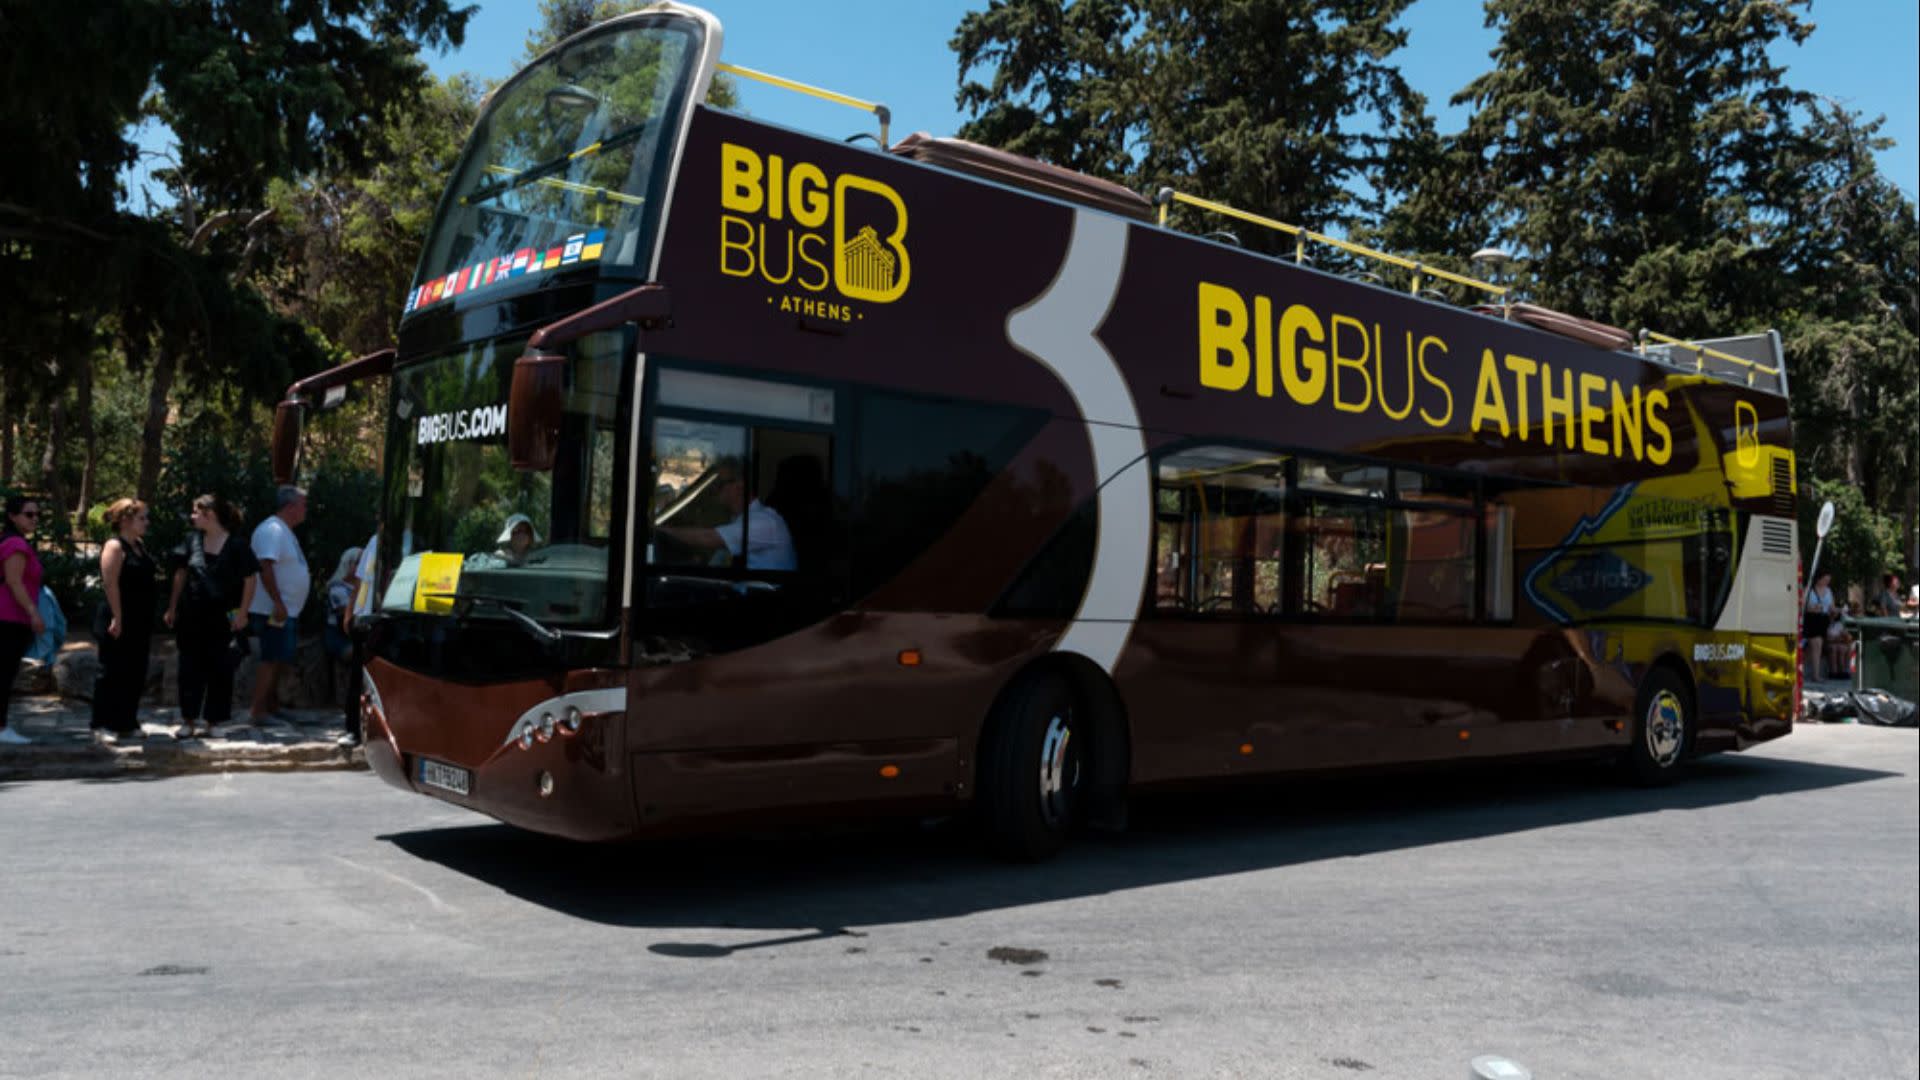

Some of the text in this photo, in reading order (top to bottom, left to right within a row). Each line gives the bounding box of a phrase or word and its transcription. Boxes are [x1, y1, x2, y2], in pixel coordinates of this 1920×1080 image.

[721, 142, 829, 228] BIG
[721, 215, 829, 291] BUS
[780, 295, 852, 322] ATHENS
[417, 403, 508, 445] BIGBUS.COM
[1471, 348, 1673, 466] ATHENS
[1693, 643, 1746, 661] BIGBUS.COM
